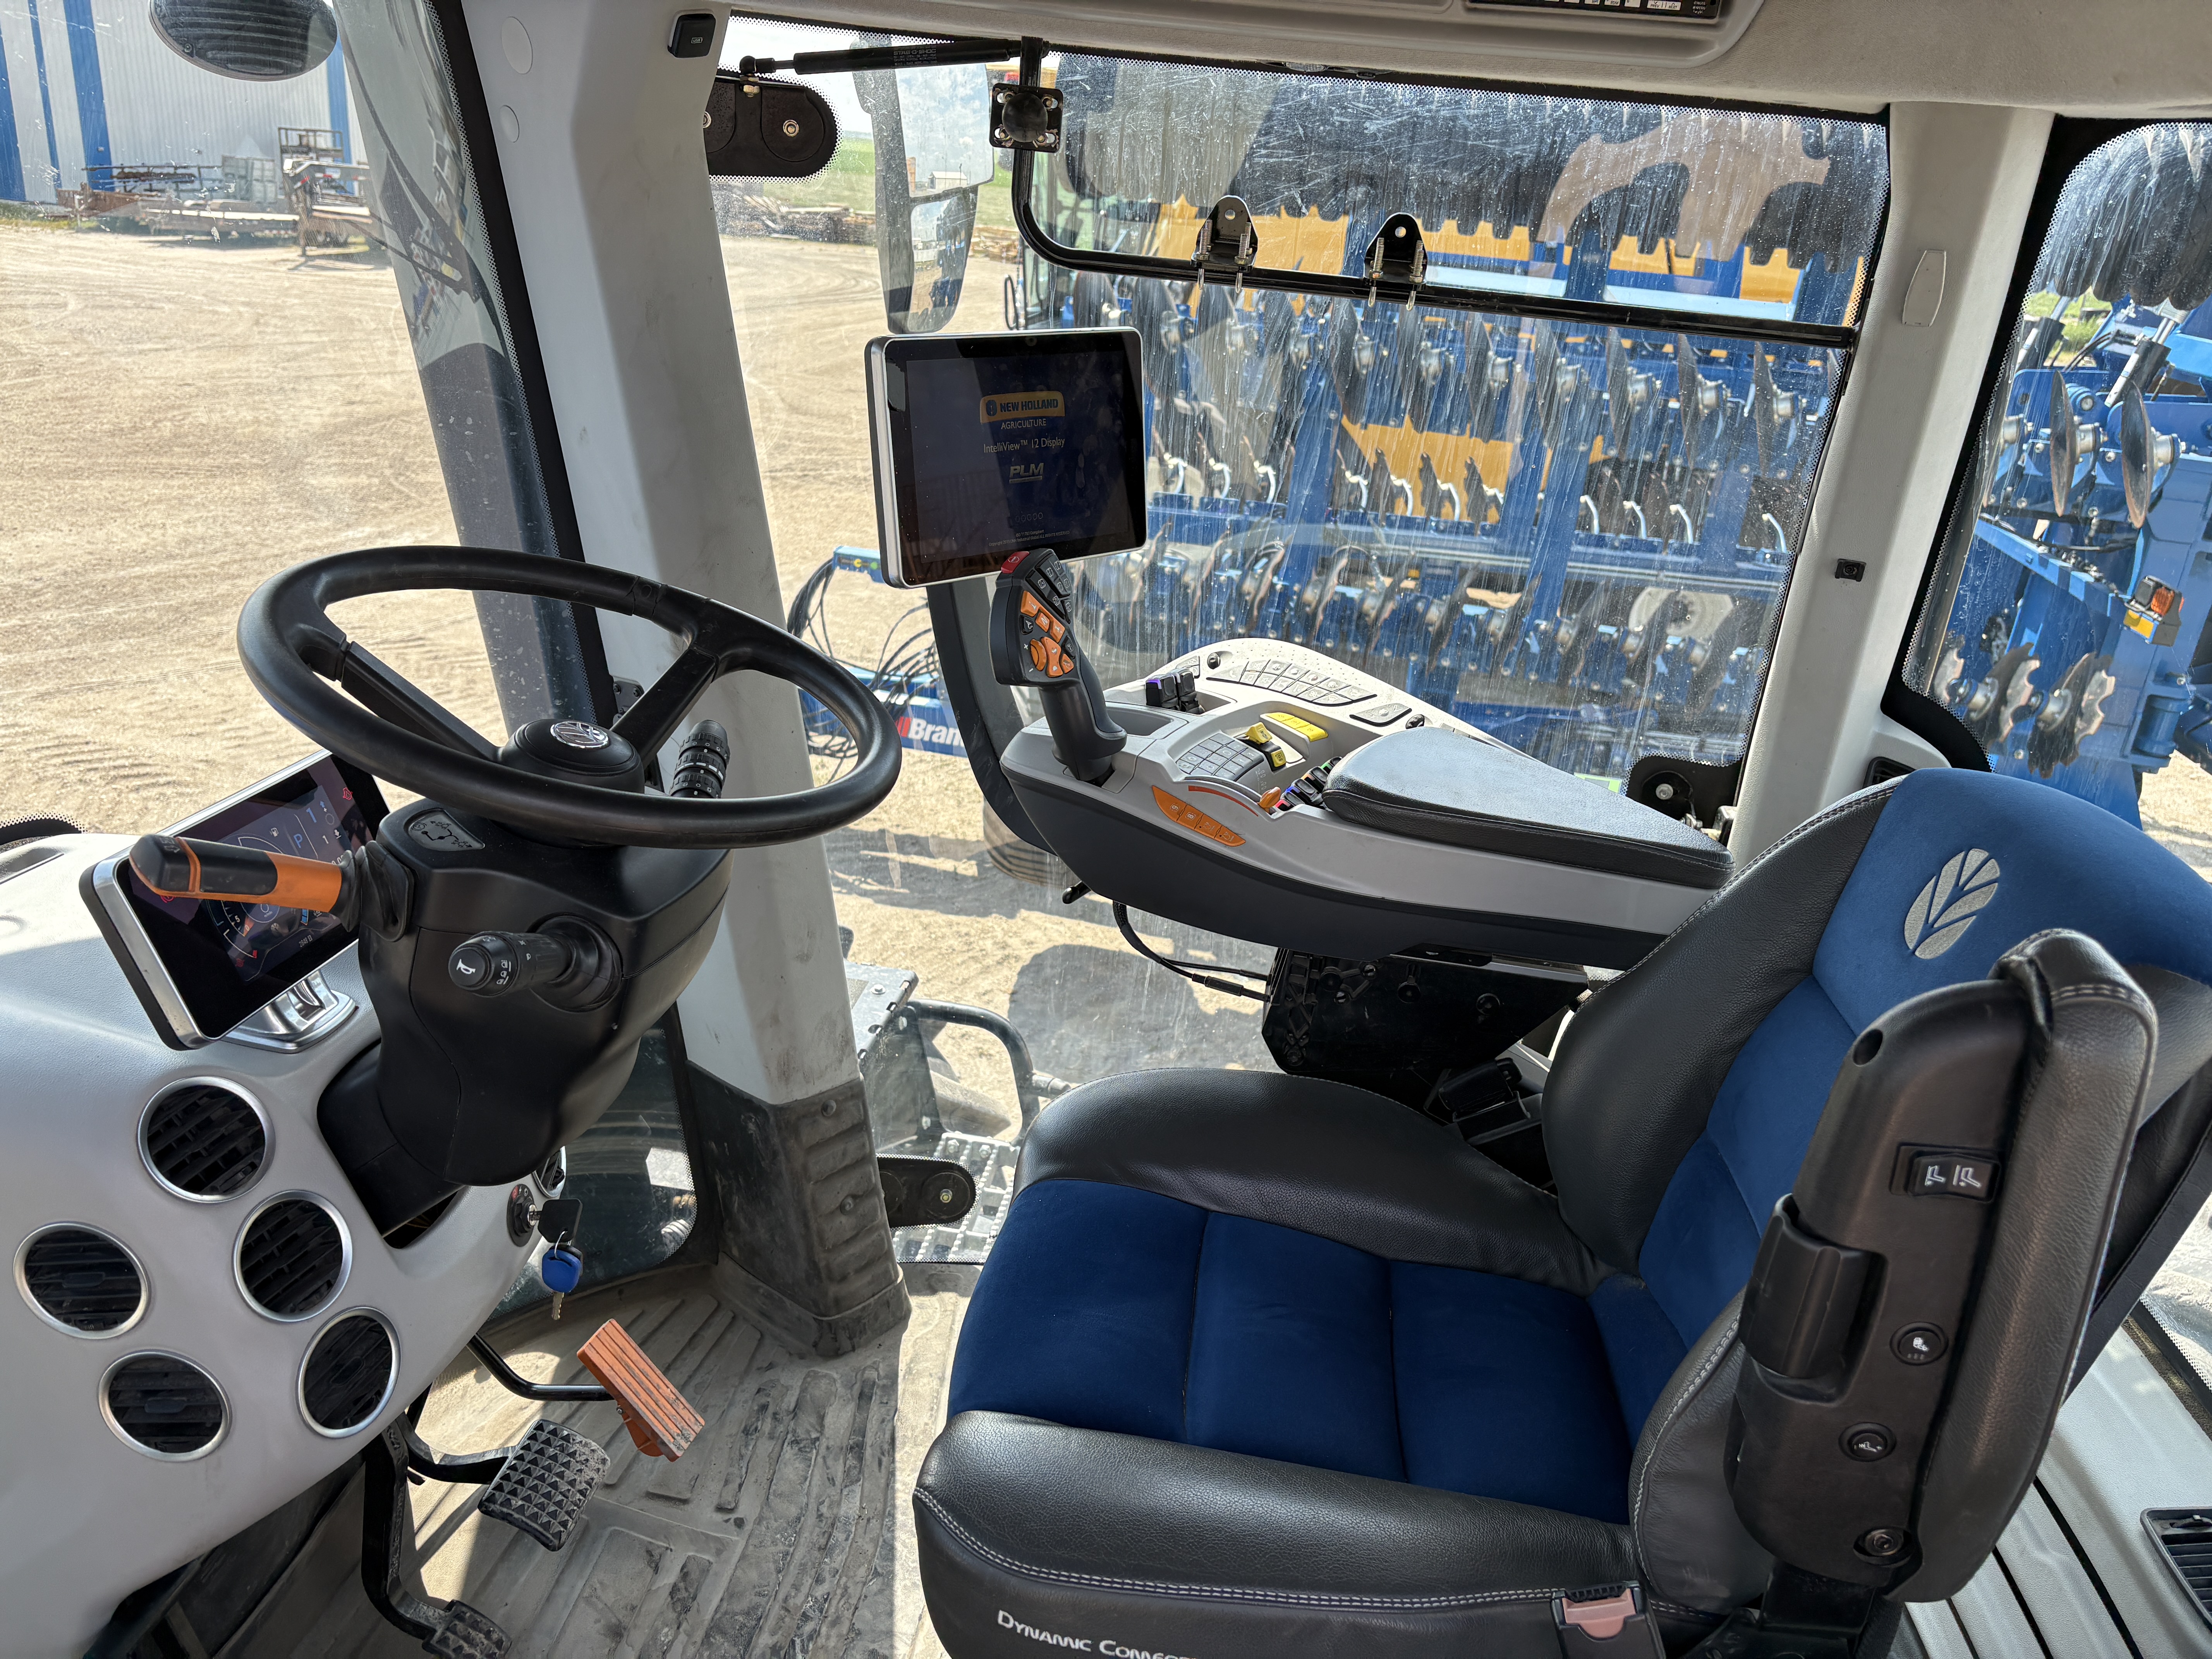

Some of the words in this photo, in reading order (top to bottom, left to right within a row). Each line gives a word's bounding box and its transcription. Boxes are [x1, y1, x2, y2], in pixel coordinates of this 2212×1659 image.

[1000, 402, 1020, 413] NEW
[1021, 398, 1058, 411] HOLLAND
[1001, 419, 1047, 430] AGRICULTURE
[1031, 439, 1039, 448] 12
[1041, 436, 1065, 449] Display
[1009, 462, 1044, 478] PLM
[908, 717, 965, 748] Bran
[306, 807, 317, 823] 1
[293, 833, 303, 848] P
[322, 835, 329, 844] 1
[997, 1609, 1092, 1652] DYNAMIC
